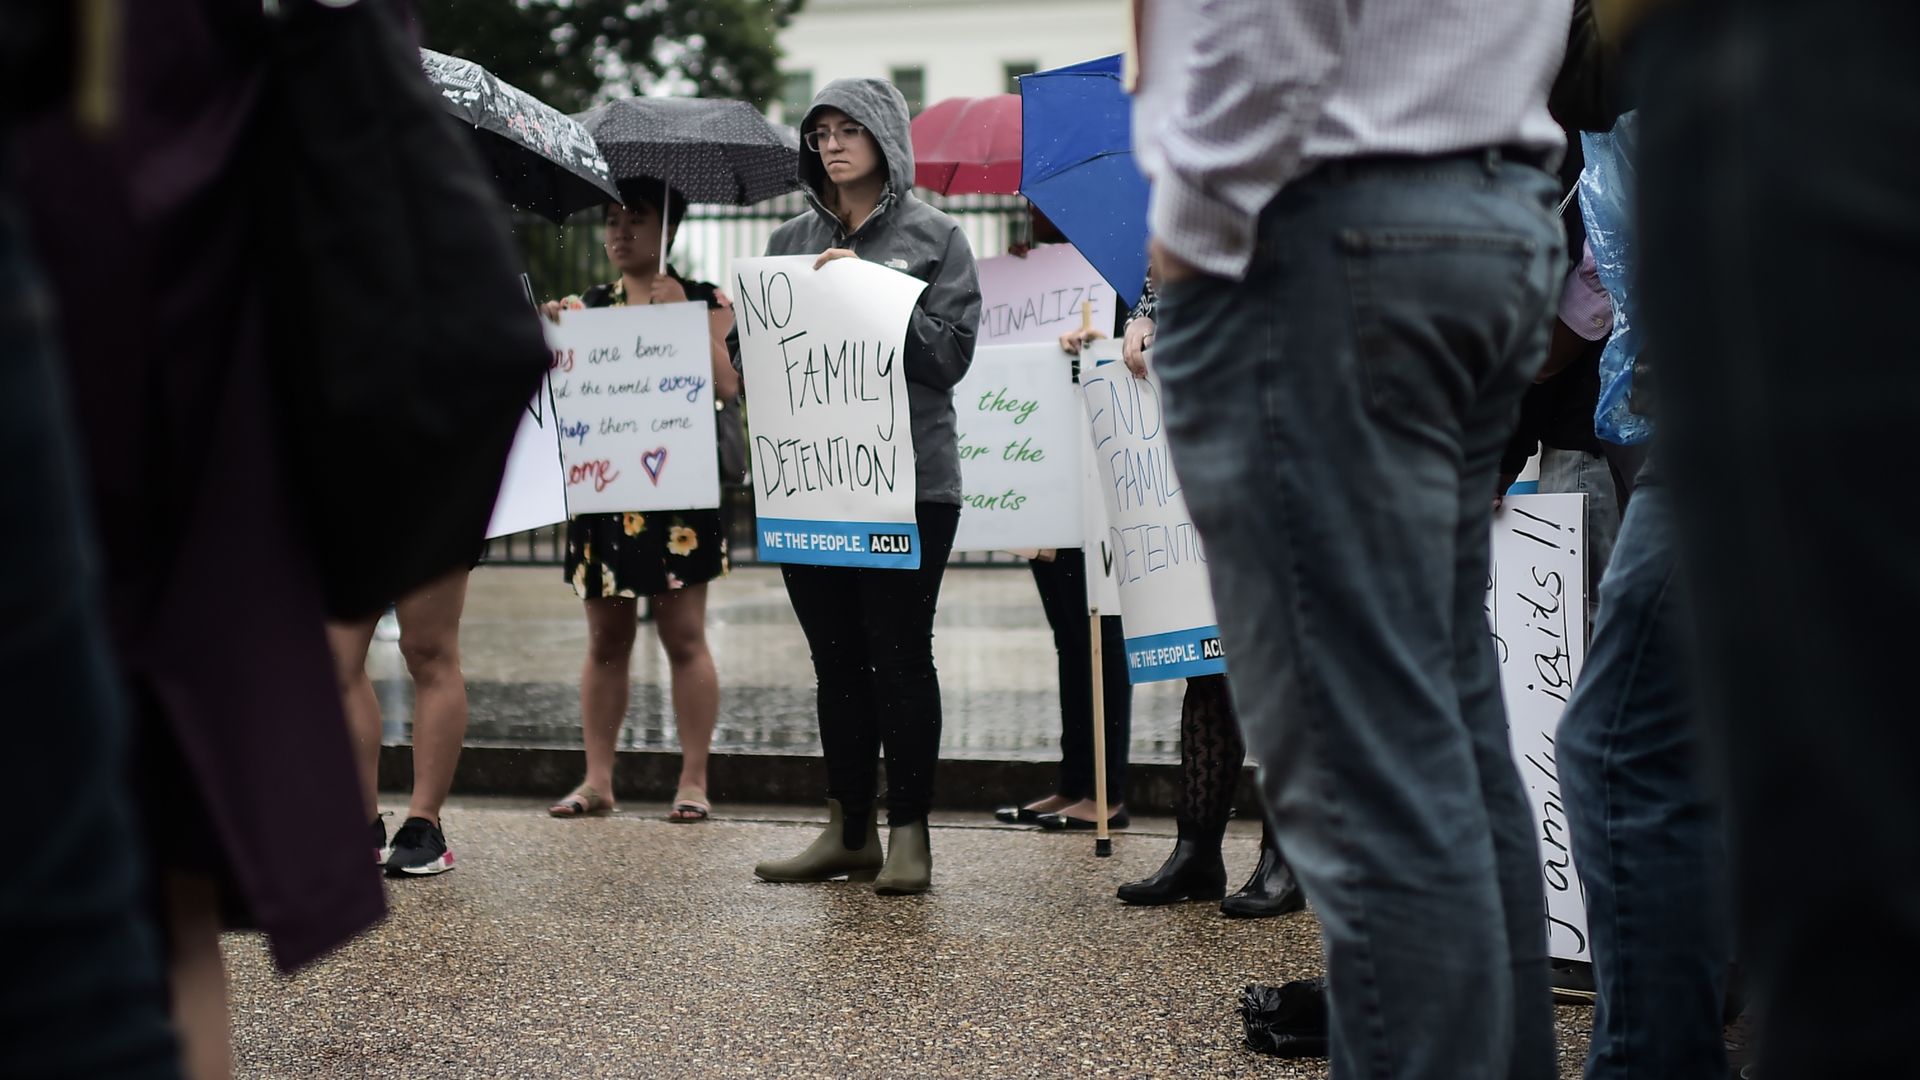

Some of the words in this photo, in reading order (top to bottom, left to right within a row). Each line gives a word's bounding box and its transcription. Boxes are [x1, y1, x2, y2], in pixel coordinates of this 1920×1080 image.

[738, 271, 792, 336] NO
[588, 347, 621, 364] are
[581, 380, 601, 395] the
[608, 377, 650, 395] world
[659, 376, 706, 403] every
[778, 330, 896, 441] FAMILY
[978, 387, 1039, 424] they
[1083, 374, 1161, 449] END
[560, 419, 590, 445] help
[598, 417, 638, 435] them
[651, 417, 693, 433] come
[1003, 437, 1045, 462] the
[567, 459, 620, 492] ome
[756, 435, 896, 500] DETENTION
[764, 531, 783, 548] WE
[785, 532, 809, 549] THE
[811, 534, 865, 552] PEOPLE.
[871, 536, 910, 553] ACLU
[1129, 652, 1141, 669] WE
[1141, 649, 1158, 667] THE
[1158, 643, 1200, 665] PEOPLE.
